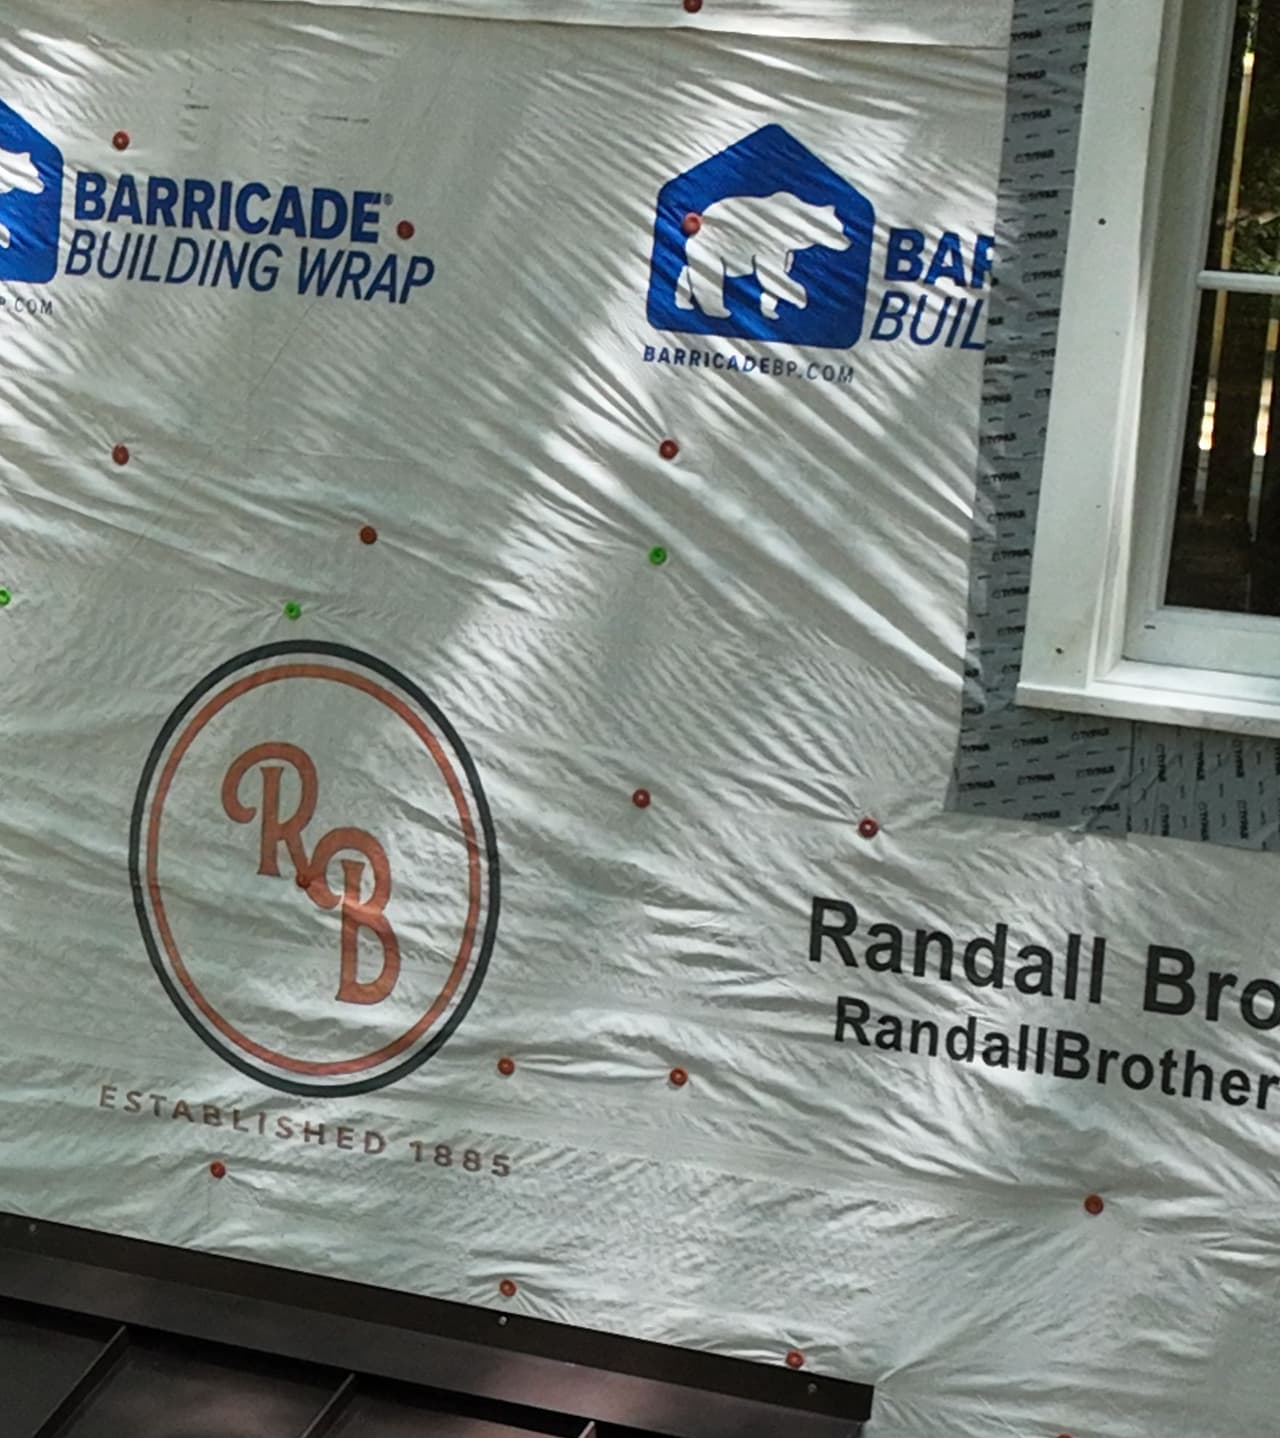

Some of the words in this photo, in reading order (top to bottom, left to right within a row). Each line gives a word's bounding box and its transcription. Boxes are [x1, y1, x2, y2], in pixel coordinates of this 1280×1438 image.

[65, 229, 283, 291] BUILDING
[297, 249, 435, 305] WRAP
[643, 344, 855, 384] BARRICADEBP.COM
[808, 895, 1107, 1005] Randall
[98, 1084, 387, 1155] ESTABLISHED
[408, 1140, 512, 1178] 1885
